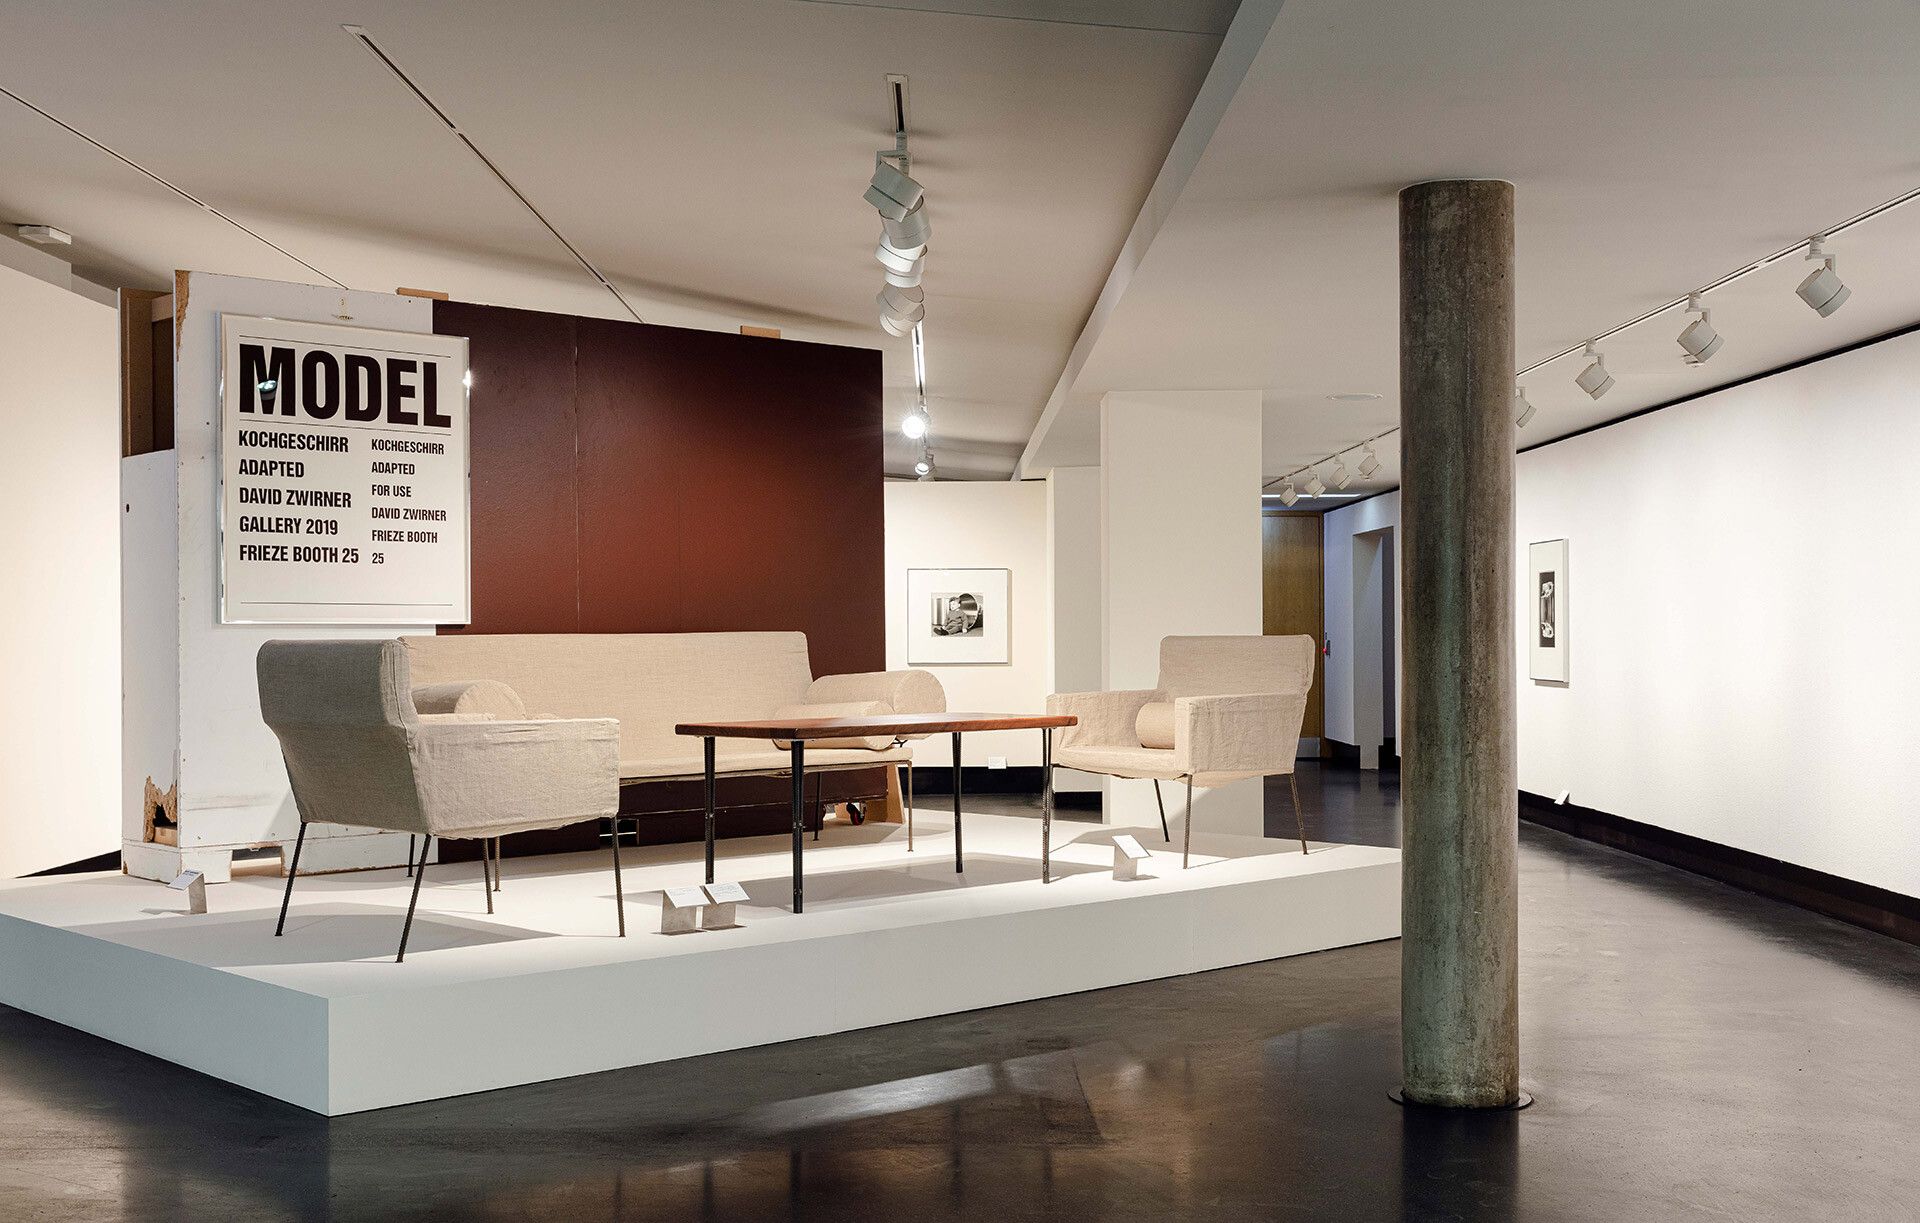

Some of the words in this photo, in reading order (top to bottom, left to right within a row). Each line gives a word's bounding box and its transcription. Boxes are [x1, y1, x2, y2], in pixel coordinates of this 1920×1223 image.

[239, 343, 452, 428] MODEL
[238, 429, 348, 452] KOCHGESCHIRR
[371, 438, 444, 454] KOCHGESCHIRR
[238, 458, 304, 477] ADAPTED
[371, 461, 414, 475] ADAPTED
[239, 486, 281, 504] DAVID
[285, 489, 351, 507] ZWIRNER
[371, 484, 389, 496] FOR
[392, 485, 411, 497] USE
[371, 506, 400, 519] DAVID
[402, 508, 446, 521] ZWIRNER
[239, 515, 301, 533] GALLERY
[305, 518, 337, 535] 2019
[371, 529, 404, 541] FRIEZE
[407, 531, 437, 543] BOOTH
[239, 544, 288, 561] FRIEZE
[292, 546, 338, 562] BOOTH
[341, 547, 358, 563] 25
[371, 552, 383, 564] 25
